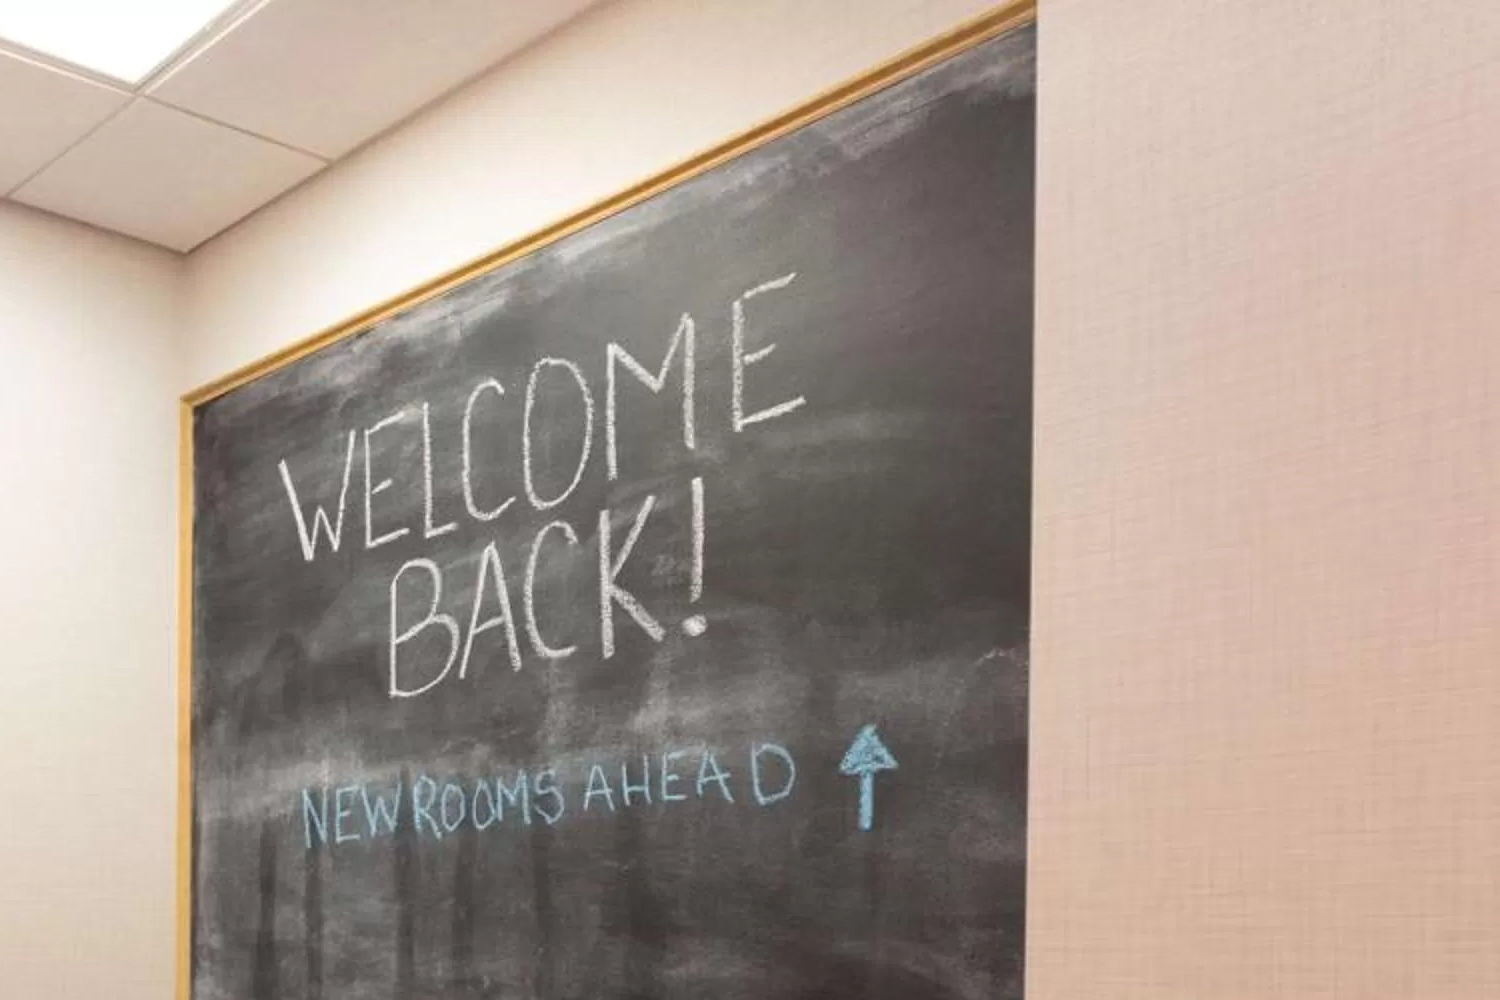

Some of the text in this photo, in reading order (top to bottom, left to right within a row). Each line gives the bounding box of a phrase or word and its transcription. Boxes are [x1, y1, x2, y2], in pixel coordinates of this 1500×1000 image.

[278, 272, 806, 561] WELCOME
[388, 476, 708, 699] BACK!
[302, 742, 797, 849] NEW ROOMS AHEAD
